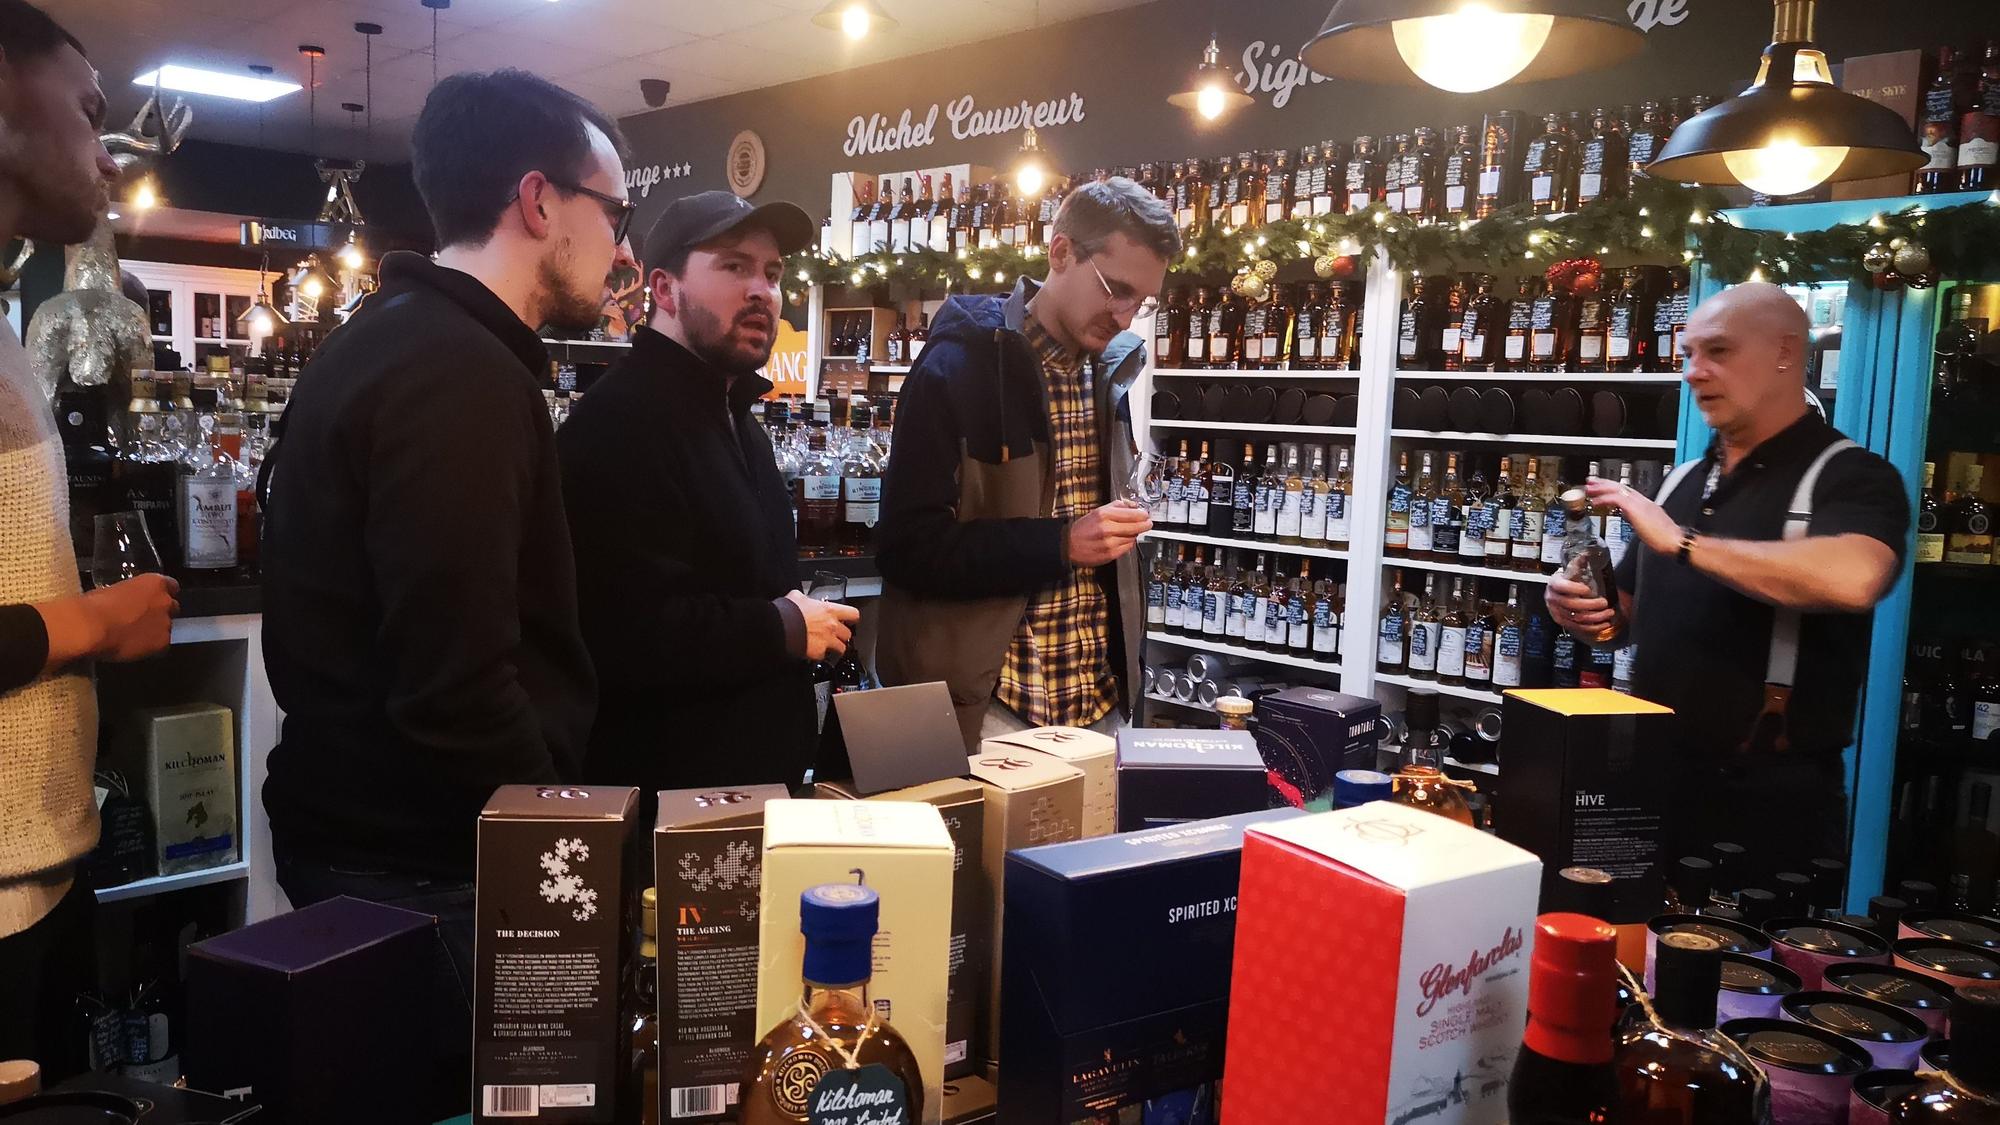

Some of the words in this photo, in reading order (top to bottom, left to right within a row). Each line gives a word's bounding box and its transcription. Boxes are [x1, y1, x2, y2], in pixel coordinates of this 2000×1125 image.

[1234, 40, 1334, 109] Sign
[843, 103, 939, 157] Michel
[946, 94, 1085, 140] Couvreur
[622, 164, 661, 198] unge
[1133, 741, 1244, 754] KILCHOMAN
[1575, 794, 1606, 807] HIVE
[1168, 900, 1220, 924] SPIRITED
[496, 930, 515, 938] THE
[517, 930, 561, 938] DECISION
[677, 927, 696, 936] THE
[698, 925, 731, 935] AGEING
[1416, 926, 1523, 1018] Glenfarclas
